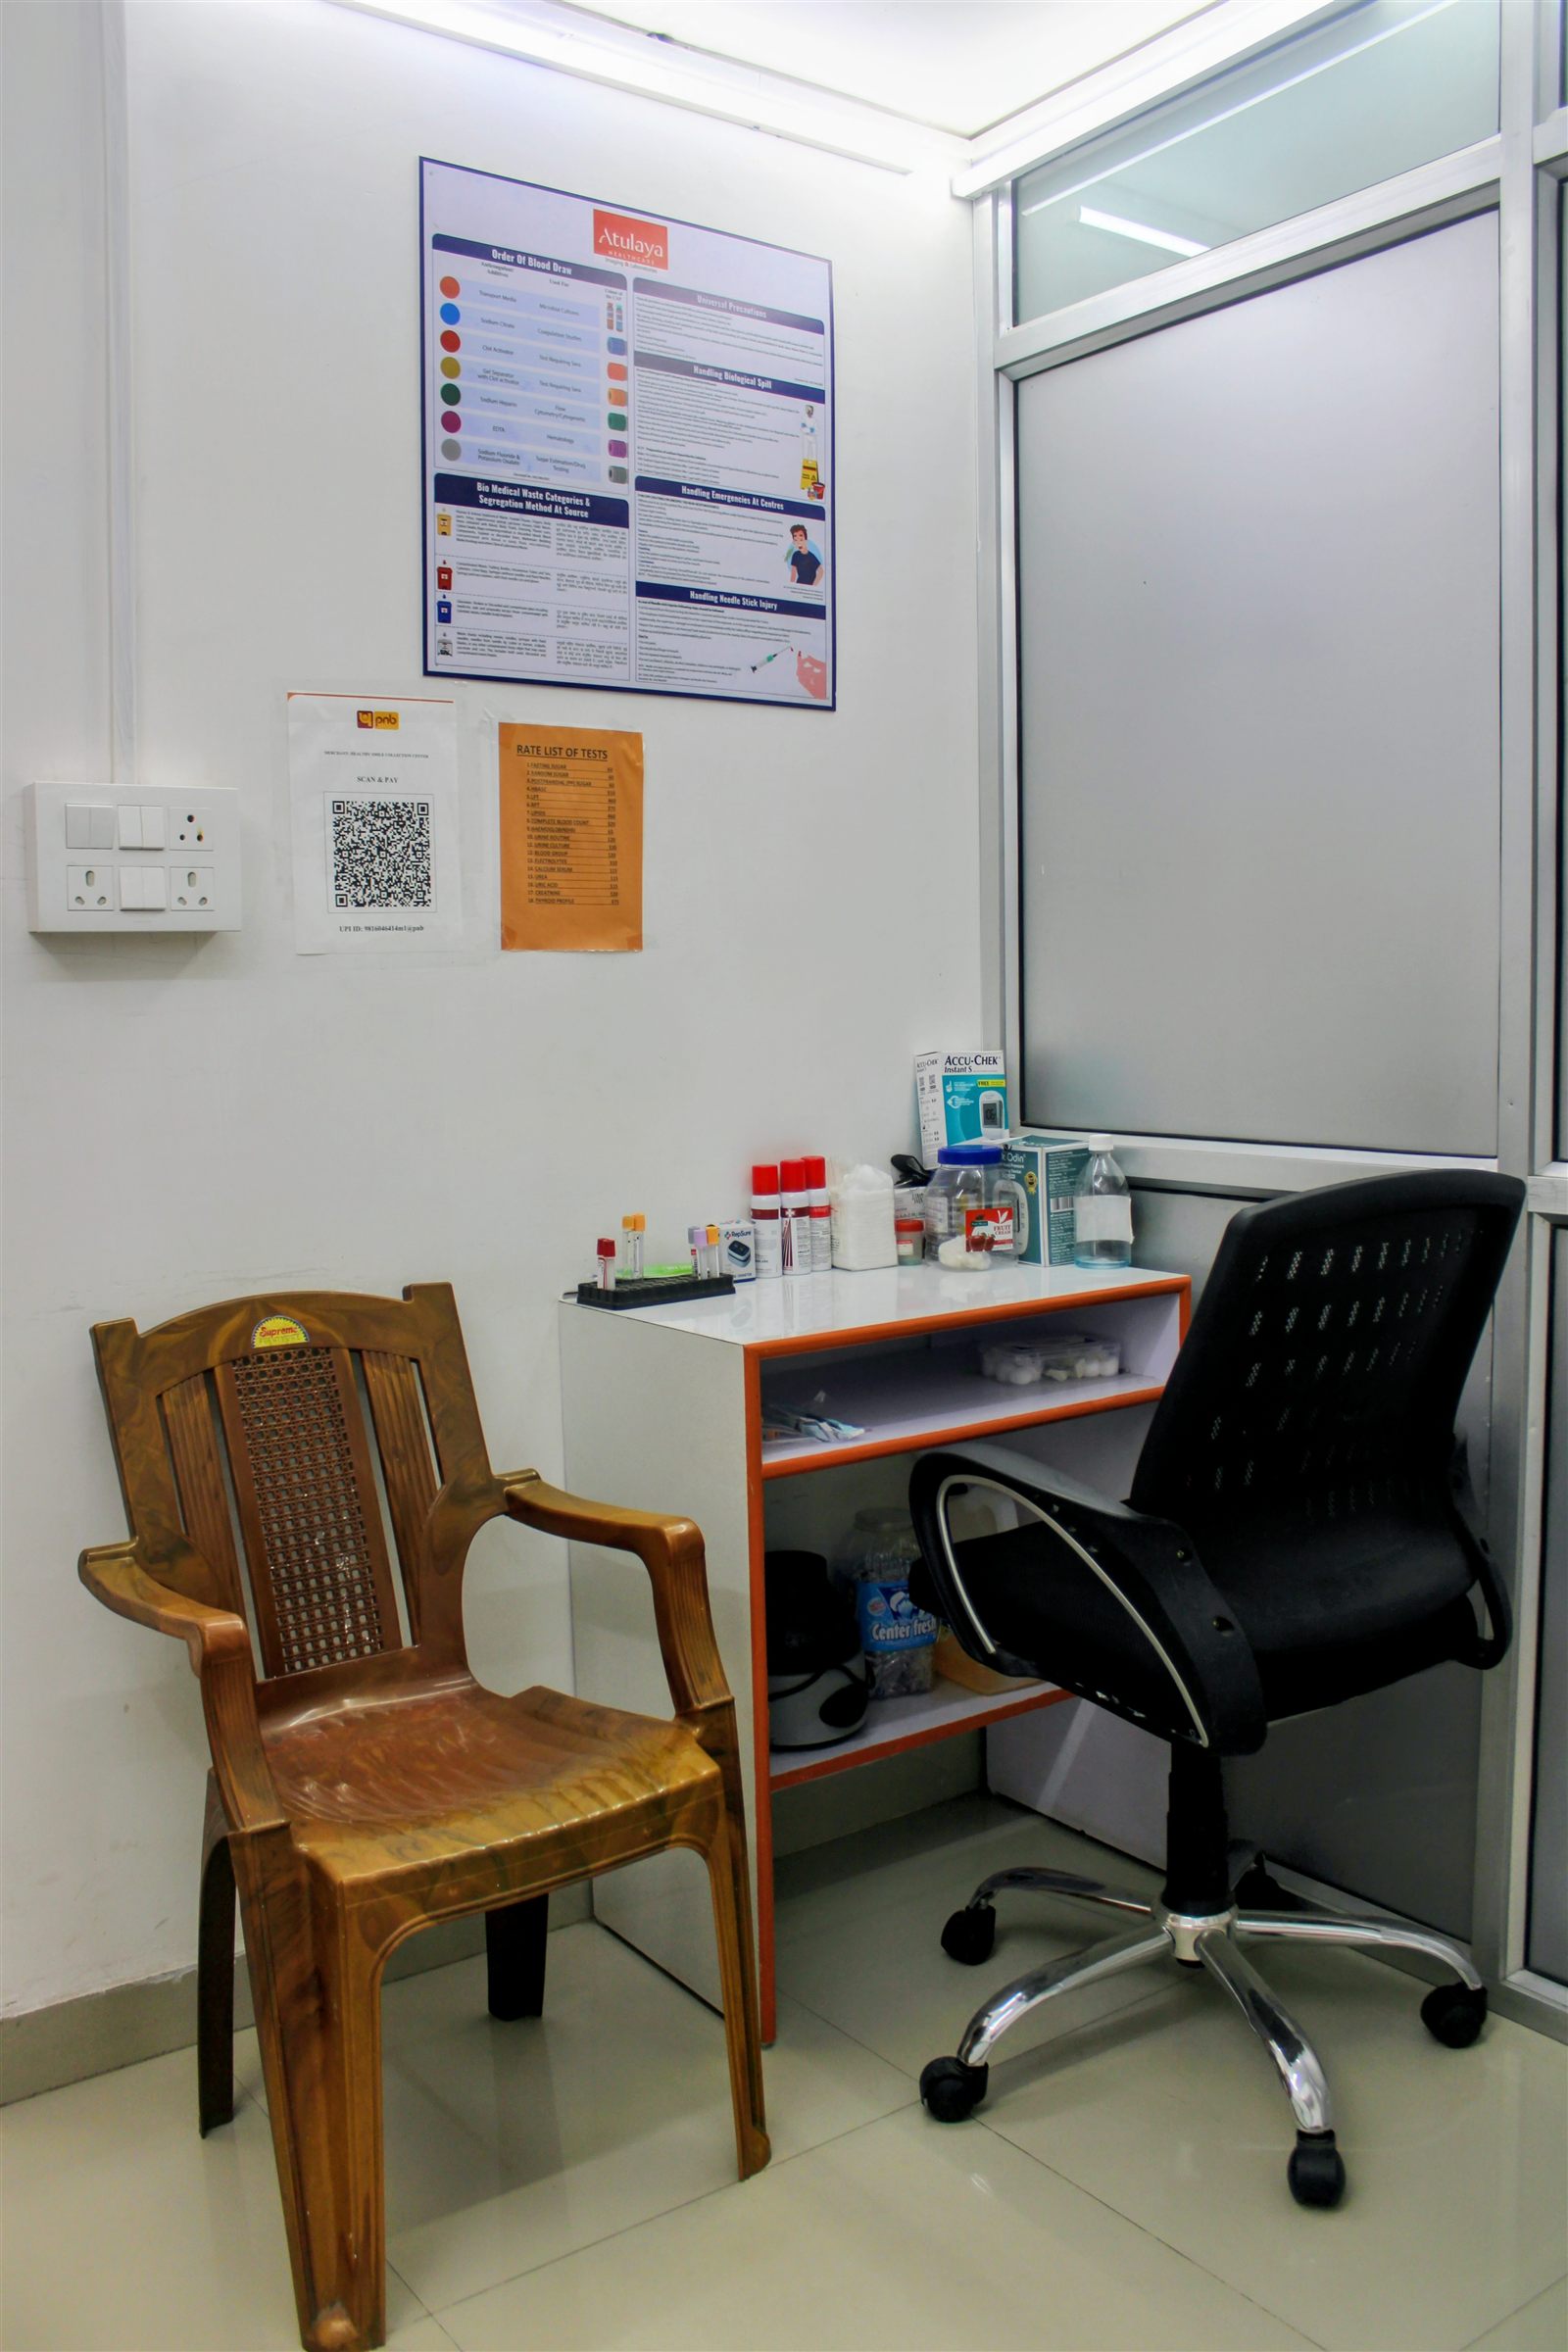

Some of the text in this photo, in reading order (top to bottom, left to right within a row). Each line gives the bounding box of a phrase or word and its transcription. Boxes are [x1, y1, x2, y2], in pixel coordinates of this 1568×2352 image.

[598, 227, 663, 258] Atulaya
[491, 249, 572, 275] Order Of Blood Draw
[697, 295, 767, 318] Universal Precautions
[693, 366, 772, 390] Handling Biological Spill
[476, 482, 591, 507] Bio Medical Waste Categories &
[479, 494, 589, 518] Segregation Method At Source
[682, 485, 784, 511] Handling Emergencies At Centres
[690, 590, 777, 612] Handling Needle Stick Injury
[375, 713, 397, 726] pnb
[516, 745, 608, 760] RATE LIST OF TESTS
[944, 1054, 999, 1066] ACCU-CHEK
[1007, 1152, 1024, 1162] Odin
[872, 1616, 937, 1641] Center fresh
